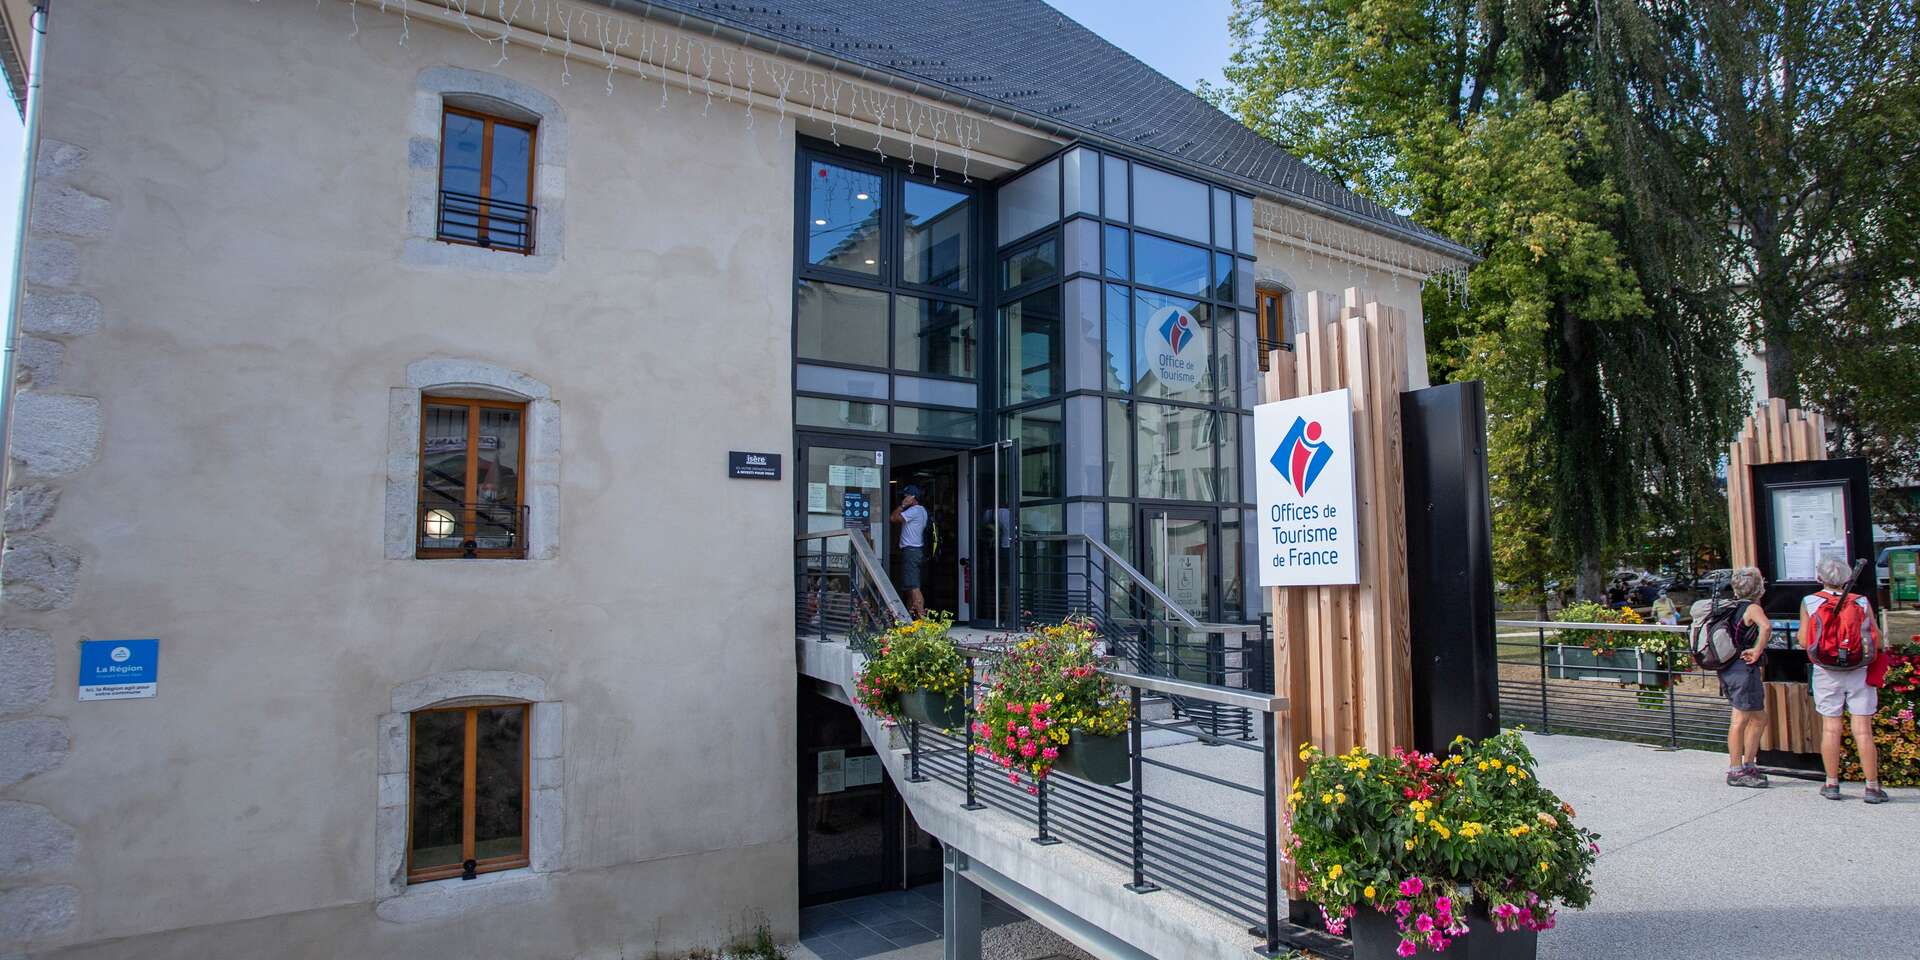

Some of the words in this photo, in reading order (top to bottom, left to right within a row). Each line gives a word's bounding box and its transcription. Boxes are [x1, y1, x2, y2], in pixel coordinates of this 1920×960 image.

[1159, 353, 1184, 368] Office
[1186, 361, 1194, 370] de
[1160, 367, 1195, 382] Tourisme
[1271, 502, 1318, 522] Offices
[1323, 504, 1336, 518] de
[1272, 525, 1337, 545] Tourisme
[1273, 554, 1285, 567] de
[1289, 548, 1338, 567] France
[109, 664, 144, 674] Région
